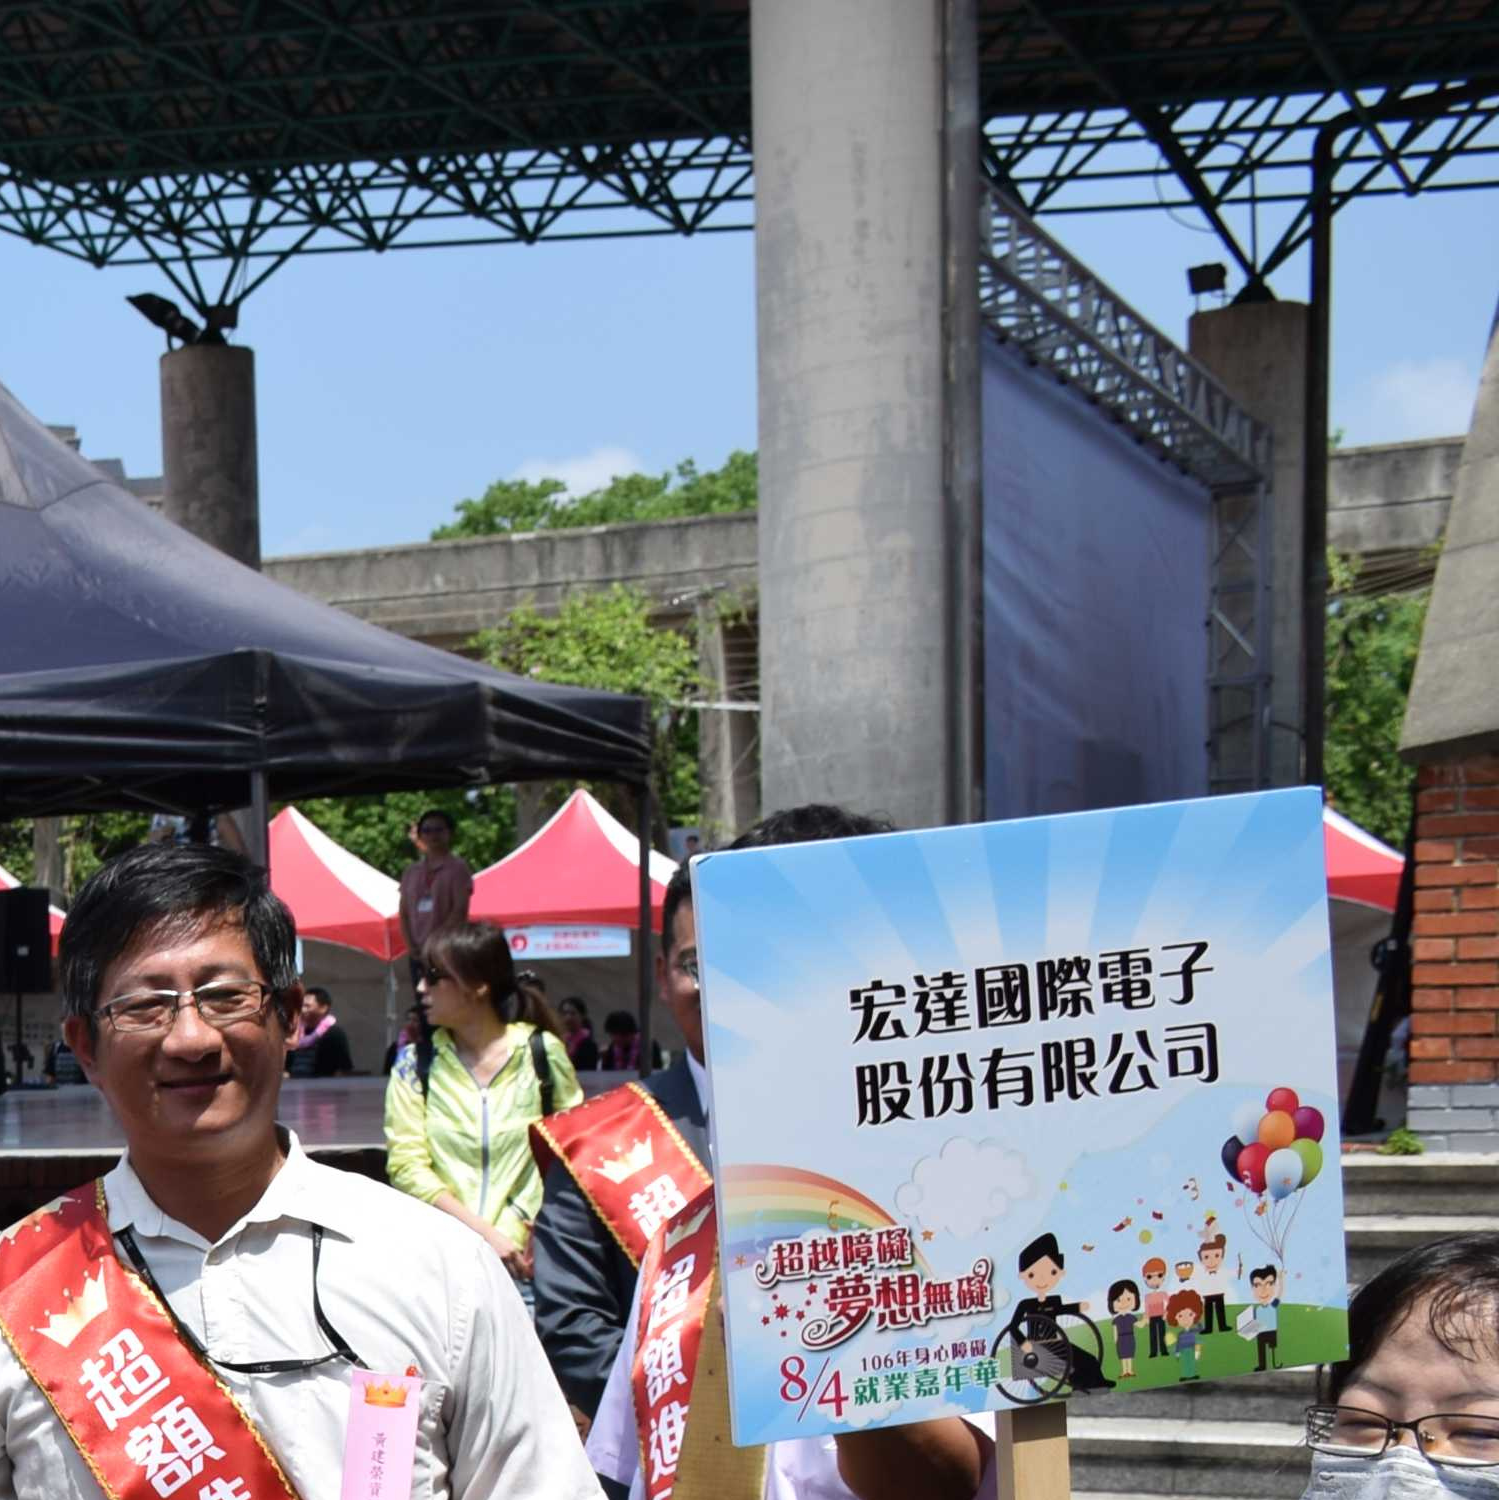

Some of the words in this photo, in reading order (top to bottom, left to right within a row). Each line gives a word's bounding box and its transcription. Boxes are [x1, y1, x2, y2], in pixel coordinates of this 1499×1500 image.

[850, 941, 1214, 1044] 宏達國際電子
[855, 1022, 1220, 1127] 股份有限公司
[756, 1228, 912, 1287] 超越障礙
[802, 1258, 992, 1350] 夢想無礙
[853, 1360, 999, 1405] 就業嘉年華
[861, 1339, 987, 1372] 106年身心障礙
[780, 1356, 849, 1422] 8/4
